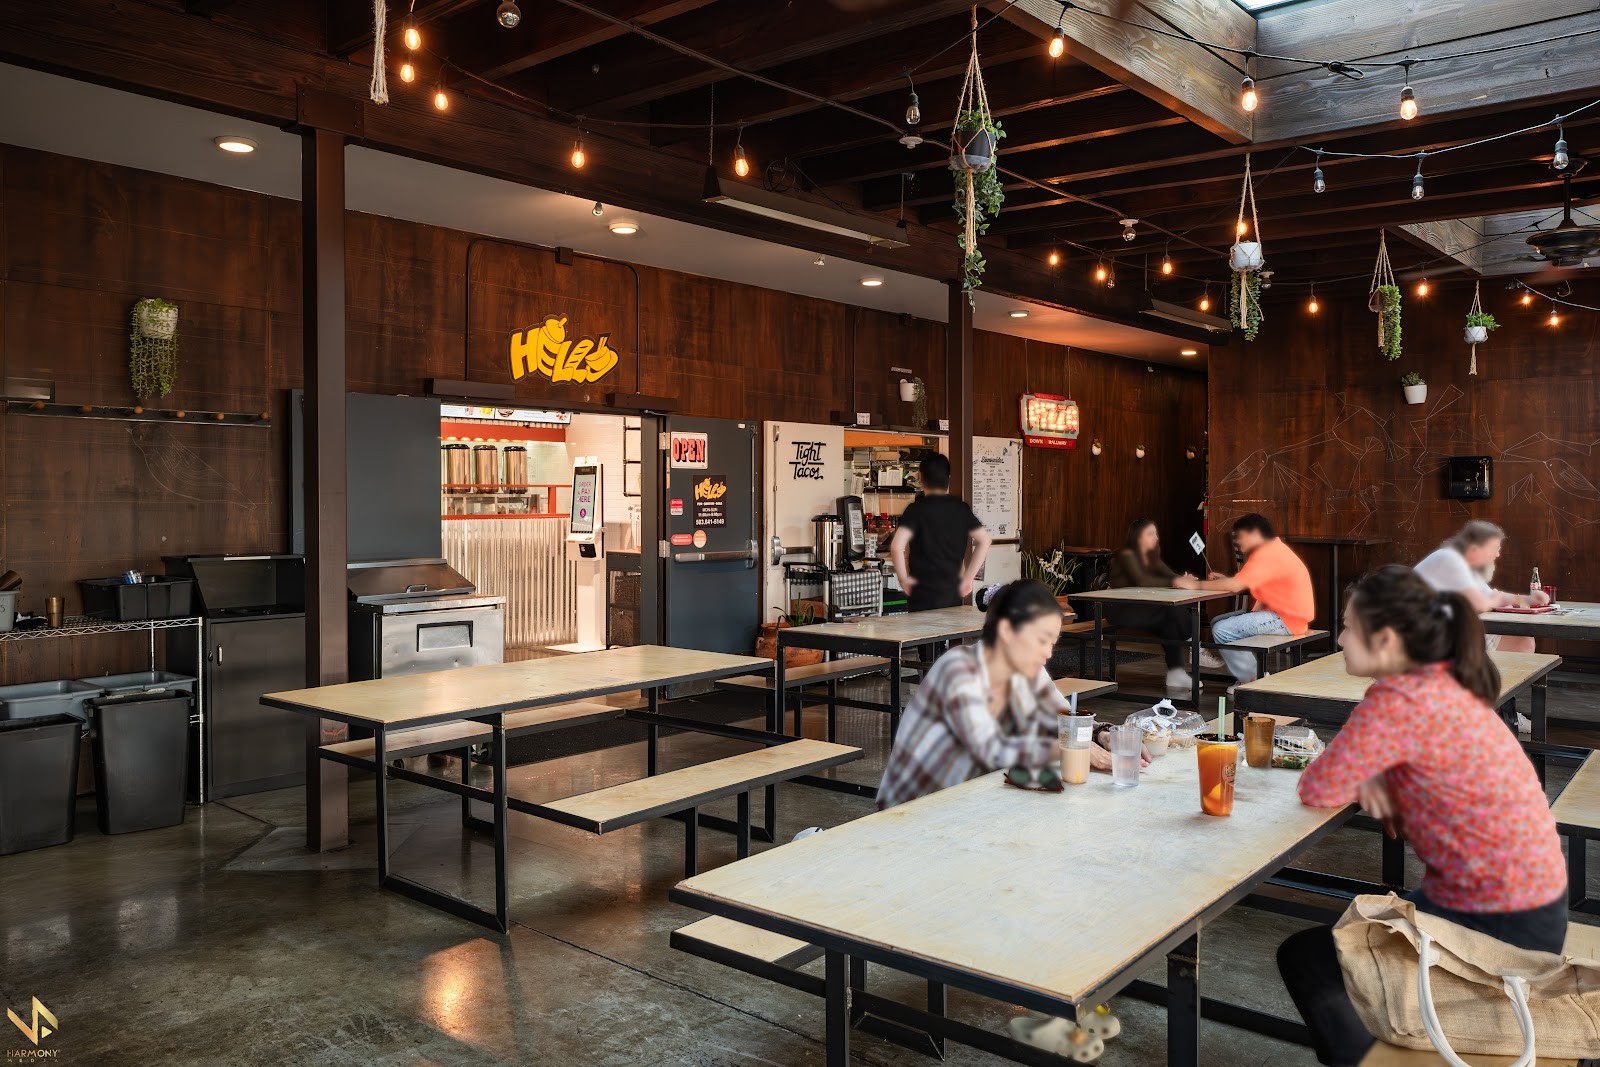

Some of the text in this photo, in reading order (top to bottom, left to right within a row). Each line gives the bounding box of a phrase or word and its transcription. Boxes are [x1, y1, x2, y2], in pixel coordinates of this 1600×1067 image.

[673, 437, 706, 463] OPEN
[791, 441, 827, 467] Tight
[578, 495, 591, 503] HERE
